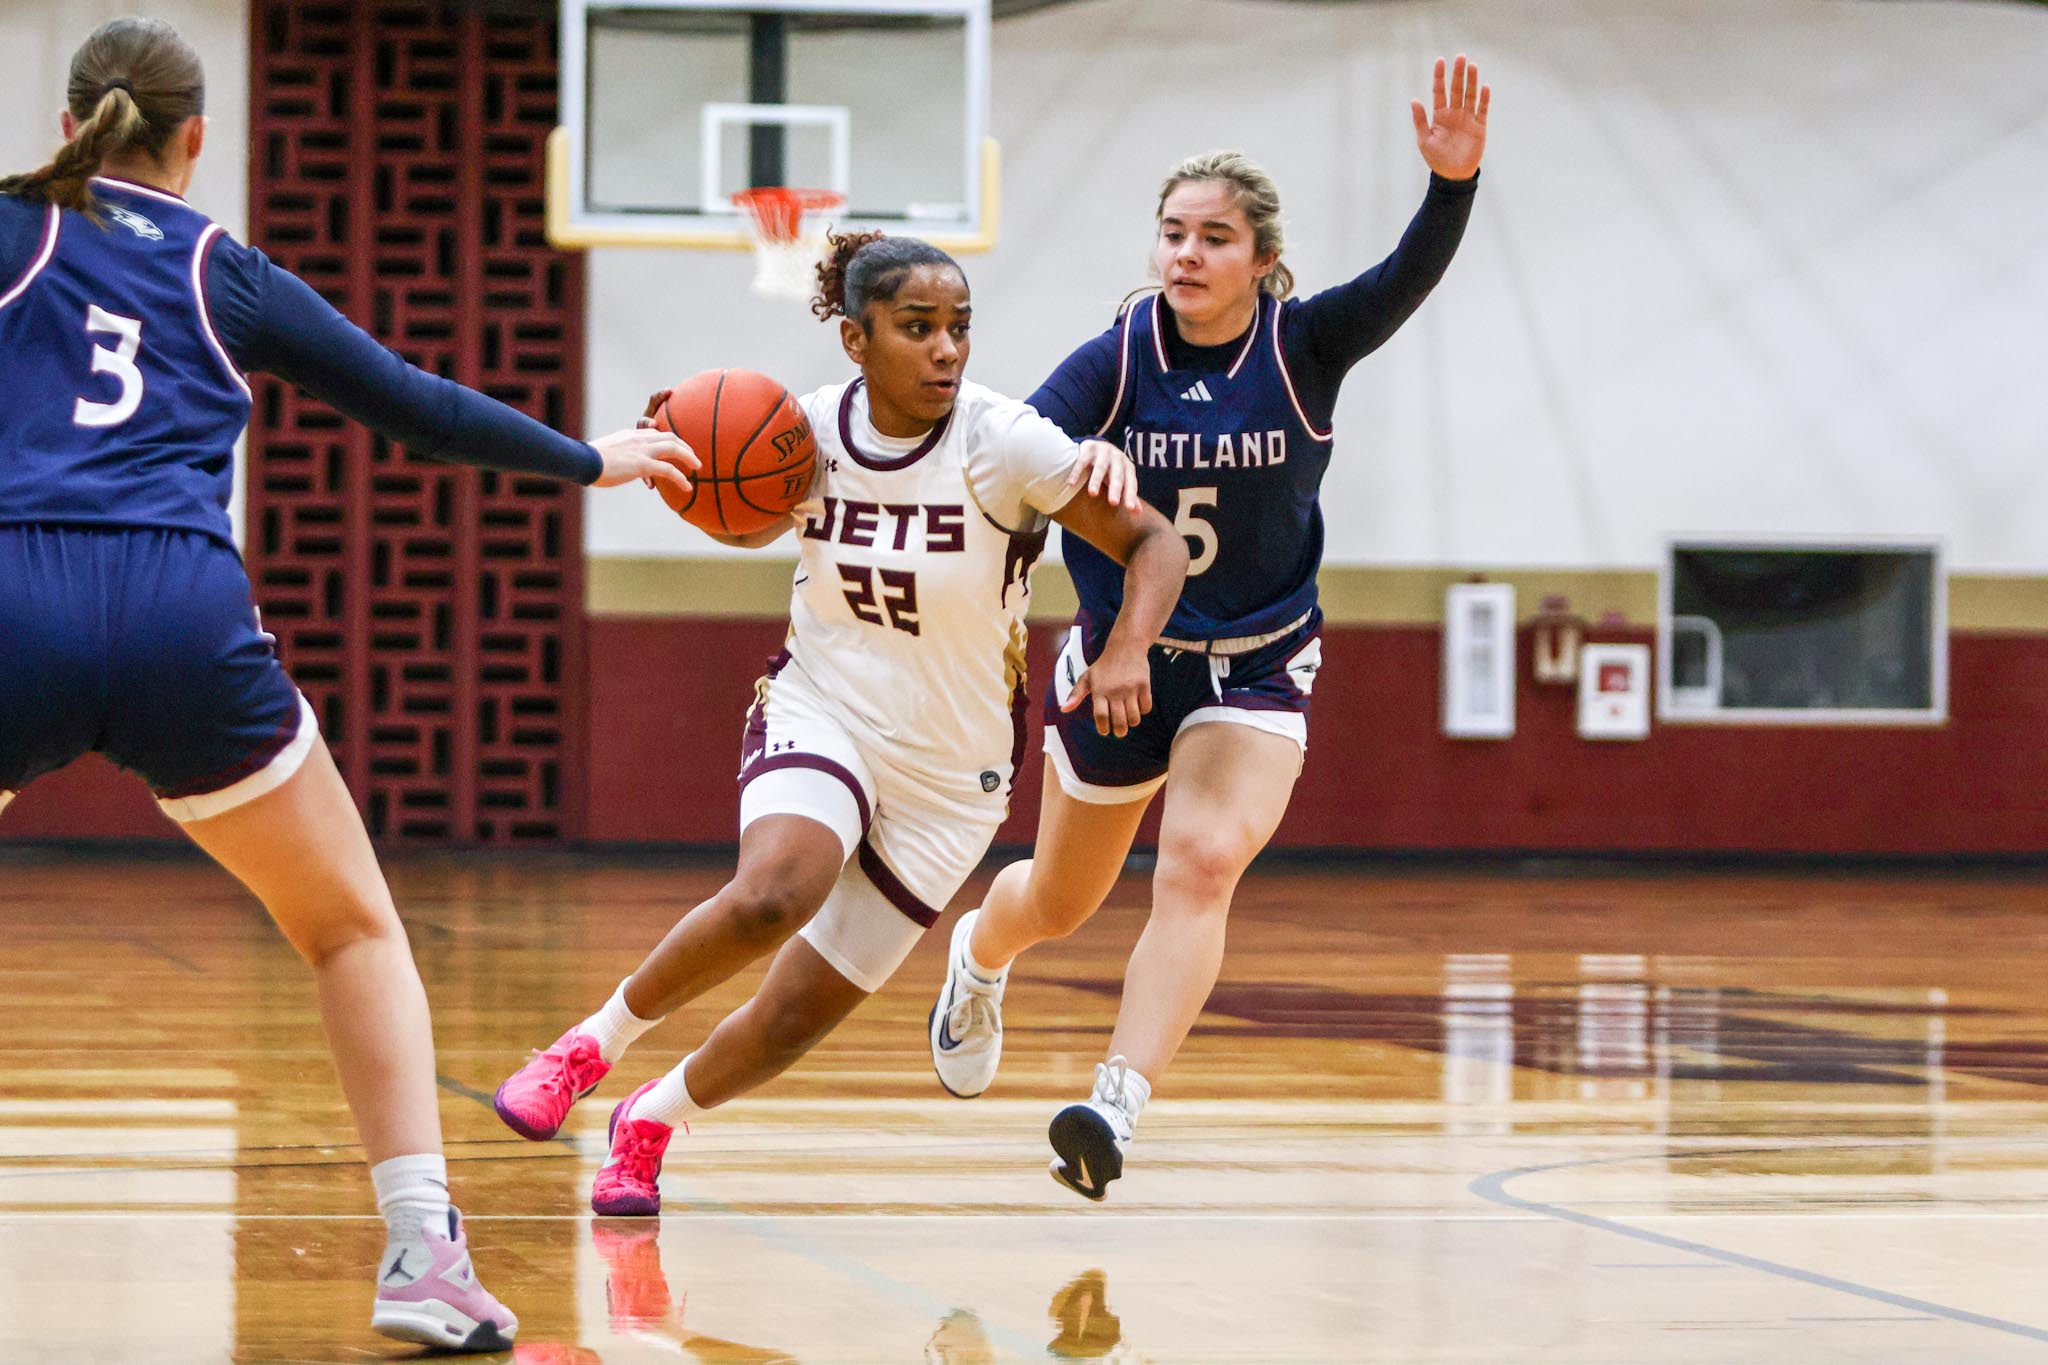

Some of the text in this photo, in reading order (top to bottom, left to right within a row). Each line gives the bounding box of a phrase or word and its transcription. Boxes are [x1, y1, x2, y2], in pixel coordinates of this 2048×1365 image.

[73, 303, 144, 427] 3
[1124, 425, 1287, 469] KIRTLAND
[803, 496, 966, 553] JETS
[1174, 486, 1220, 577] 5
[836, 562, 921, 637] 22
